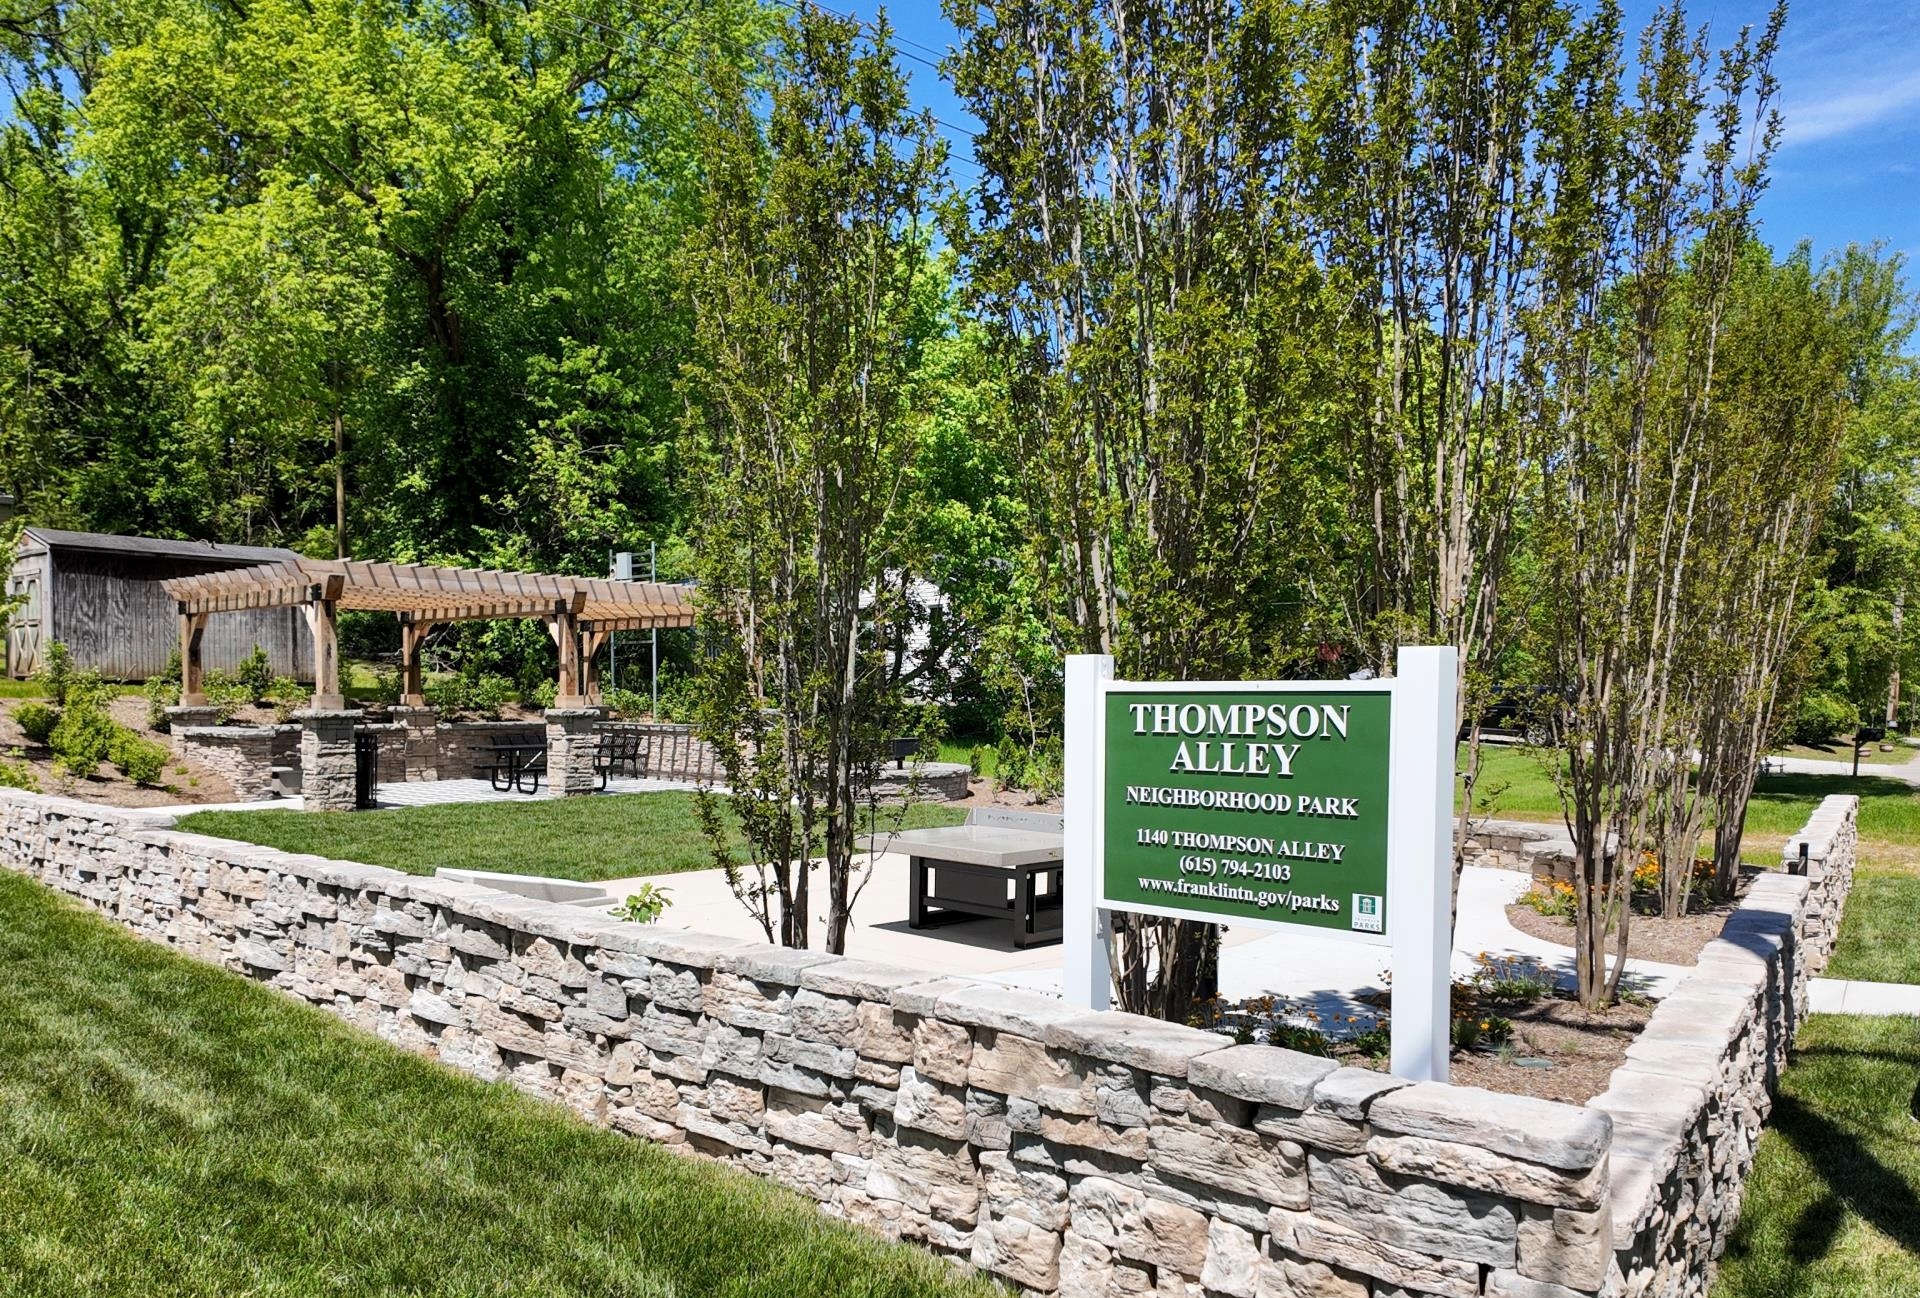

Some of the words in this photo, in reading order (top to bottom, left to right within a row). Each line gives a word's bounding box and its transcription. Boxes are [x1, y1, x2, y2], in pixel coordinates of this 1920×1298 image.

[1129, 704, 1350, 738] THOMPSON
[1170, 741, 1300, 776] ALLEY
[1126, 786, 1292, 812] NEIGHBORHOOD
[1297, 796, 1359, 816] PARK
[1137, 829, 1168, 845] 1140
[1172, 831, 1273, 855] THOMPSON
[1278, 841, 1345, 861] ALLEY
[1179, 856, 1217, 876] (615)
[1221, 860, 1291, 881] 794-2103
[1138, 877, 1339, 912] www.franklintn.gov/parks
[1354, 921, 1380, 930] PARKS
